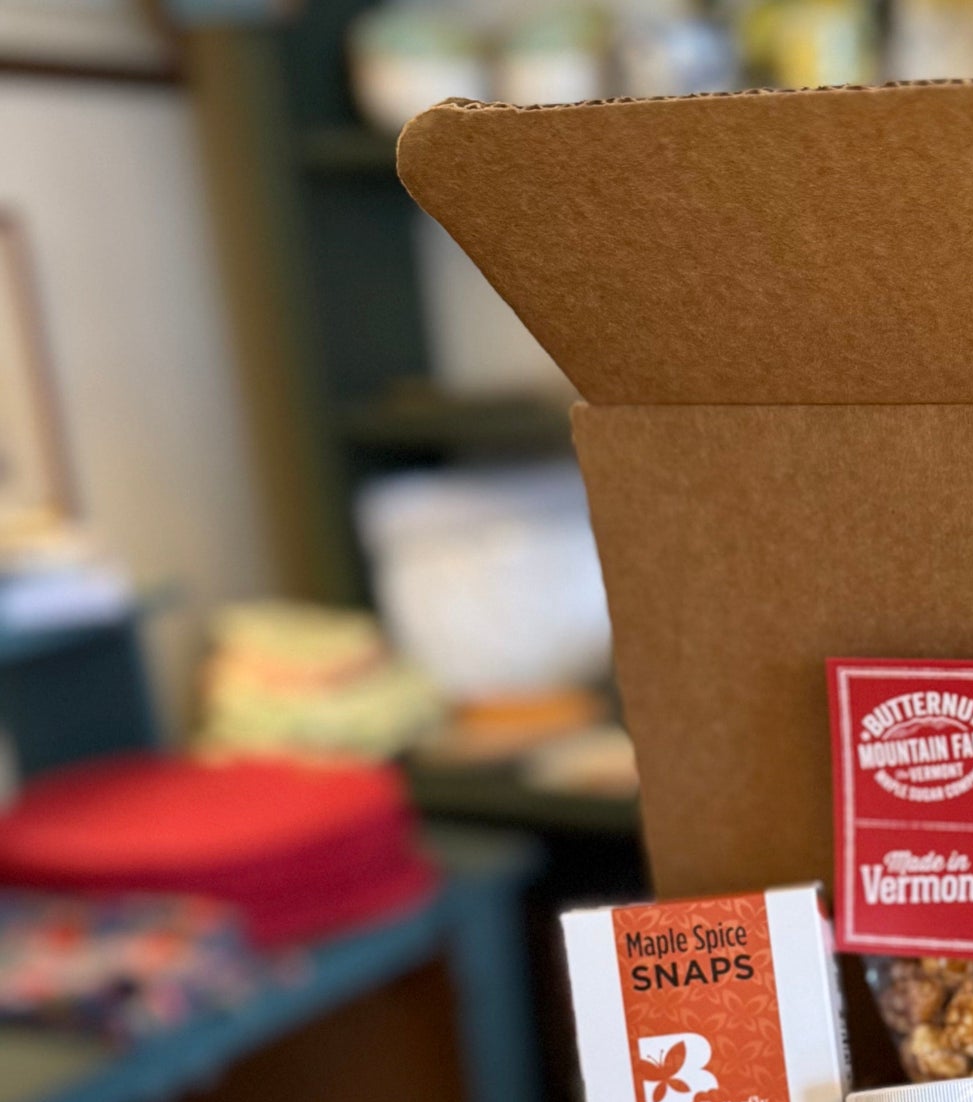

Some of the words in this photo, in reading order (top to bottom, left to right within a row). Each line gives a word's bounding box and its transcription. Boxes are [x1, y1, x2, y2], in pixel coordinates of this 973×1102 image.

[857, 735, 949, 770] MOUNTAIN
[883, 850, 945, 875] Made
[946, 850, 971, 873] in
[625, 926, 688, 960] Maple
[692, 922, 748, 954] Spice
[631, 954, 755, 993] SNAPS
